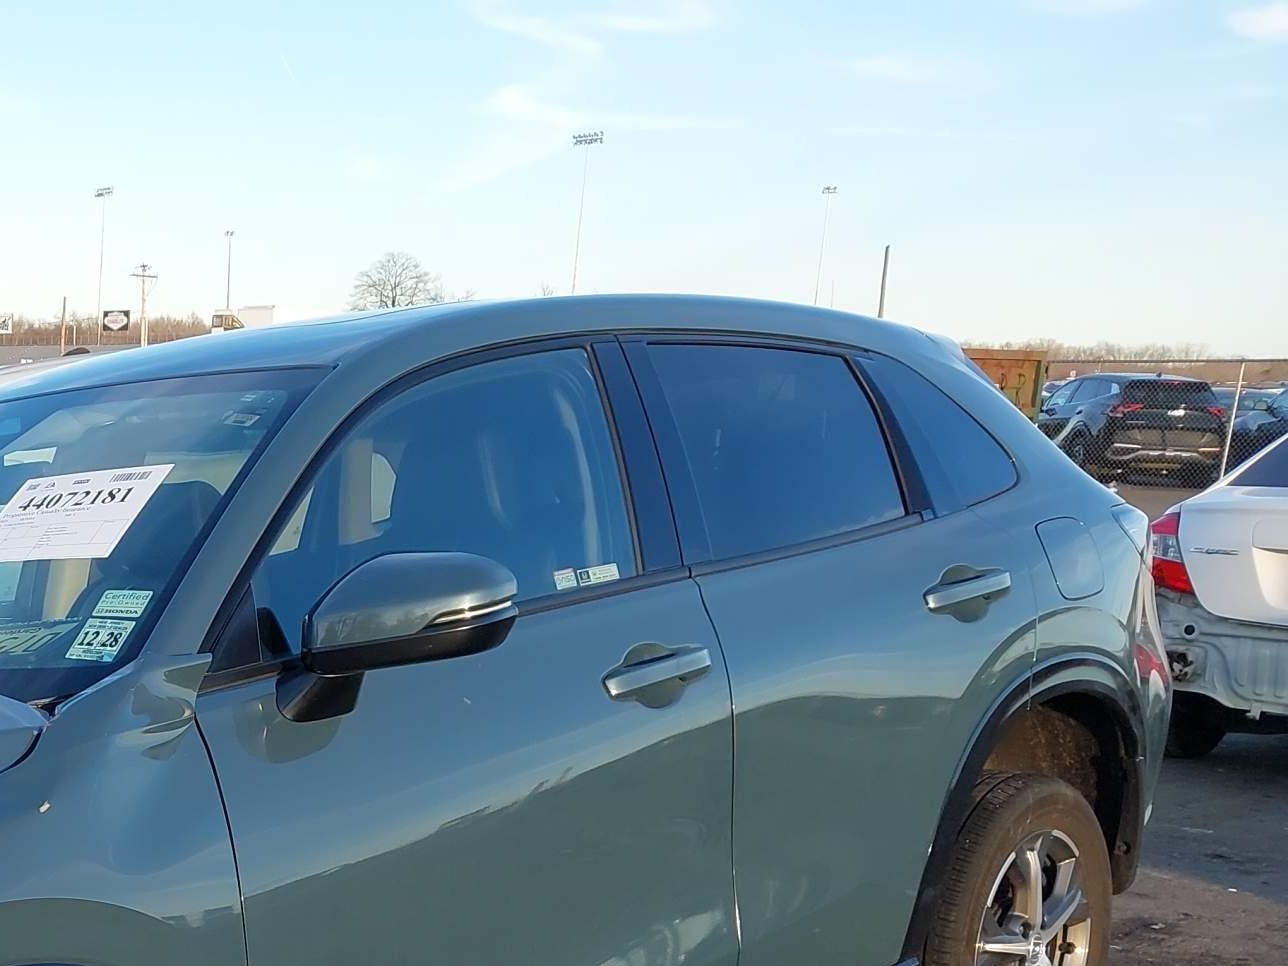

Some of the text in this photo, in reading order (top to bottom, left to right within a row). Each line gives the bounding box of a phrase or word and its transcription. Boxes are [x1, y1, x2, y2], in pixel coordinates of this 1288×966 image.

[18, 486, 135, 511] 44072181
[104, 592, 151, 601] Certified
[77, 630, 101, 647] 12
[100, 631, 123, 648] 28
